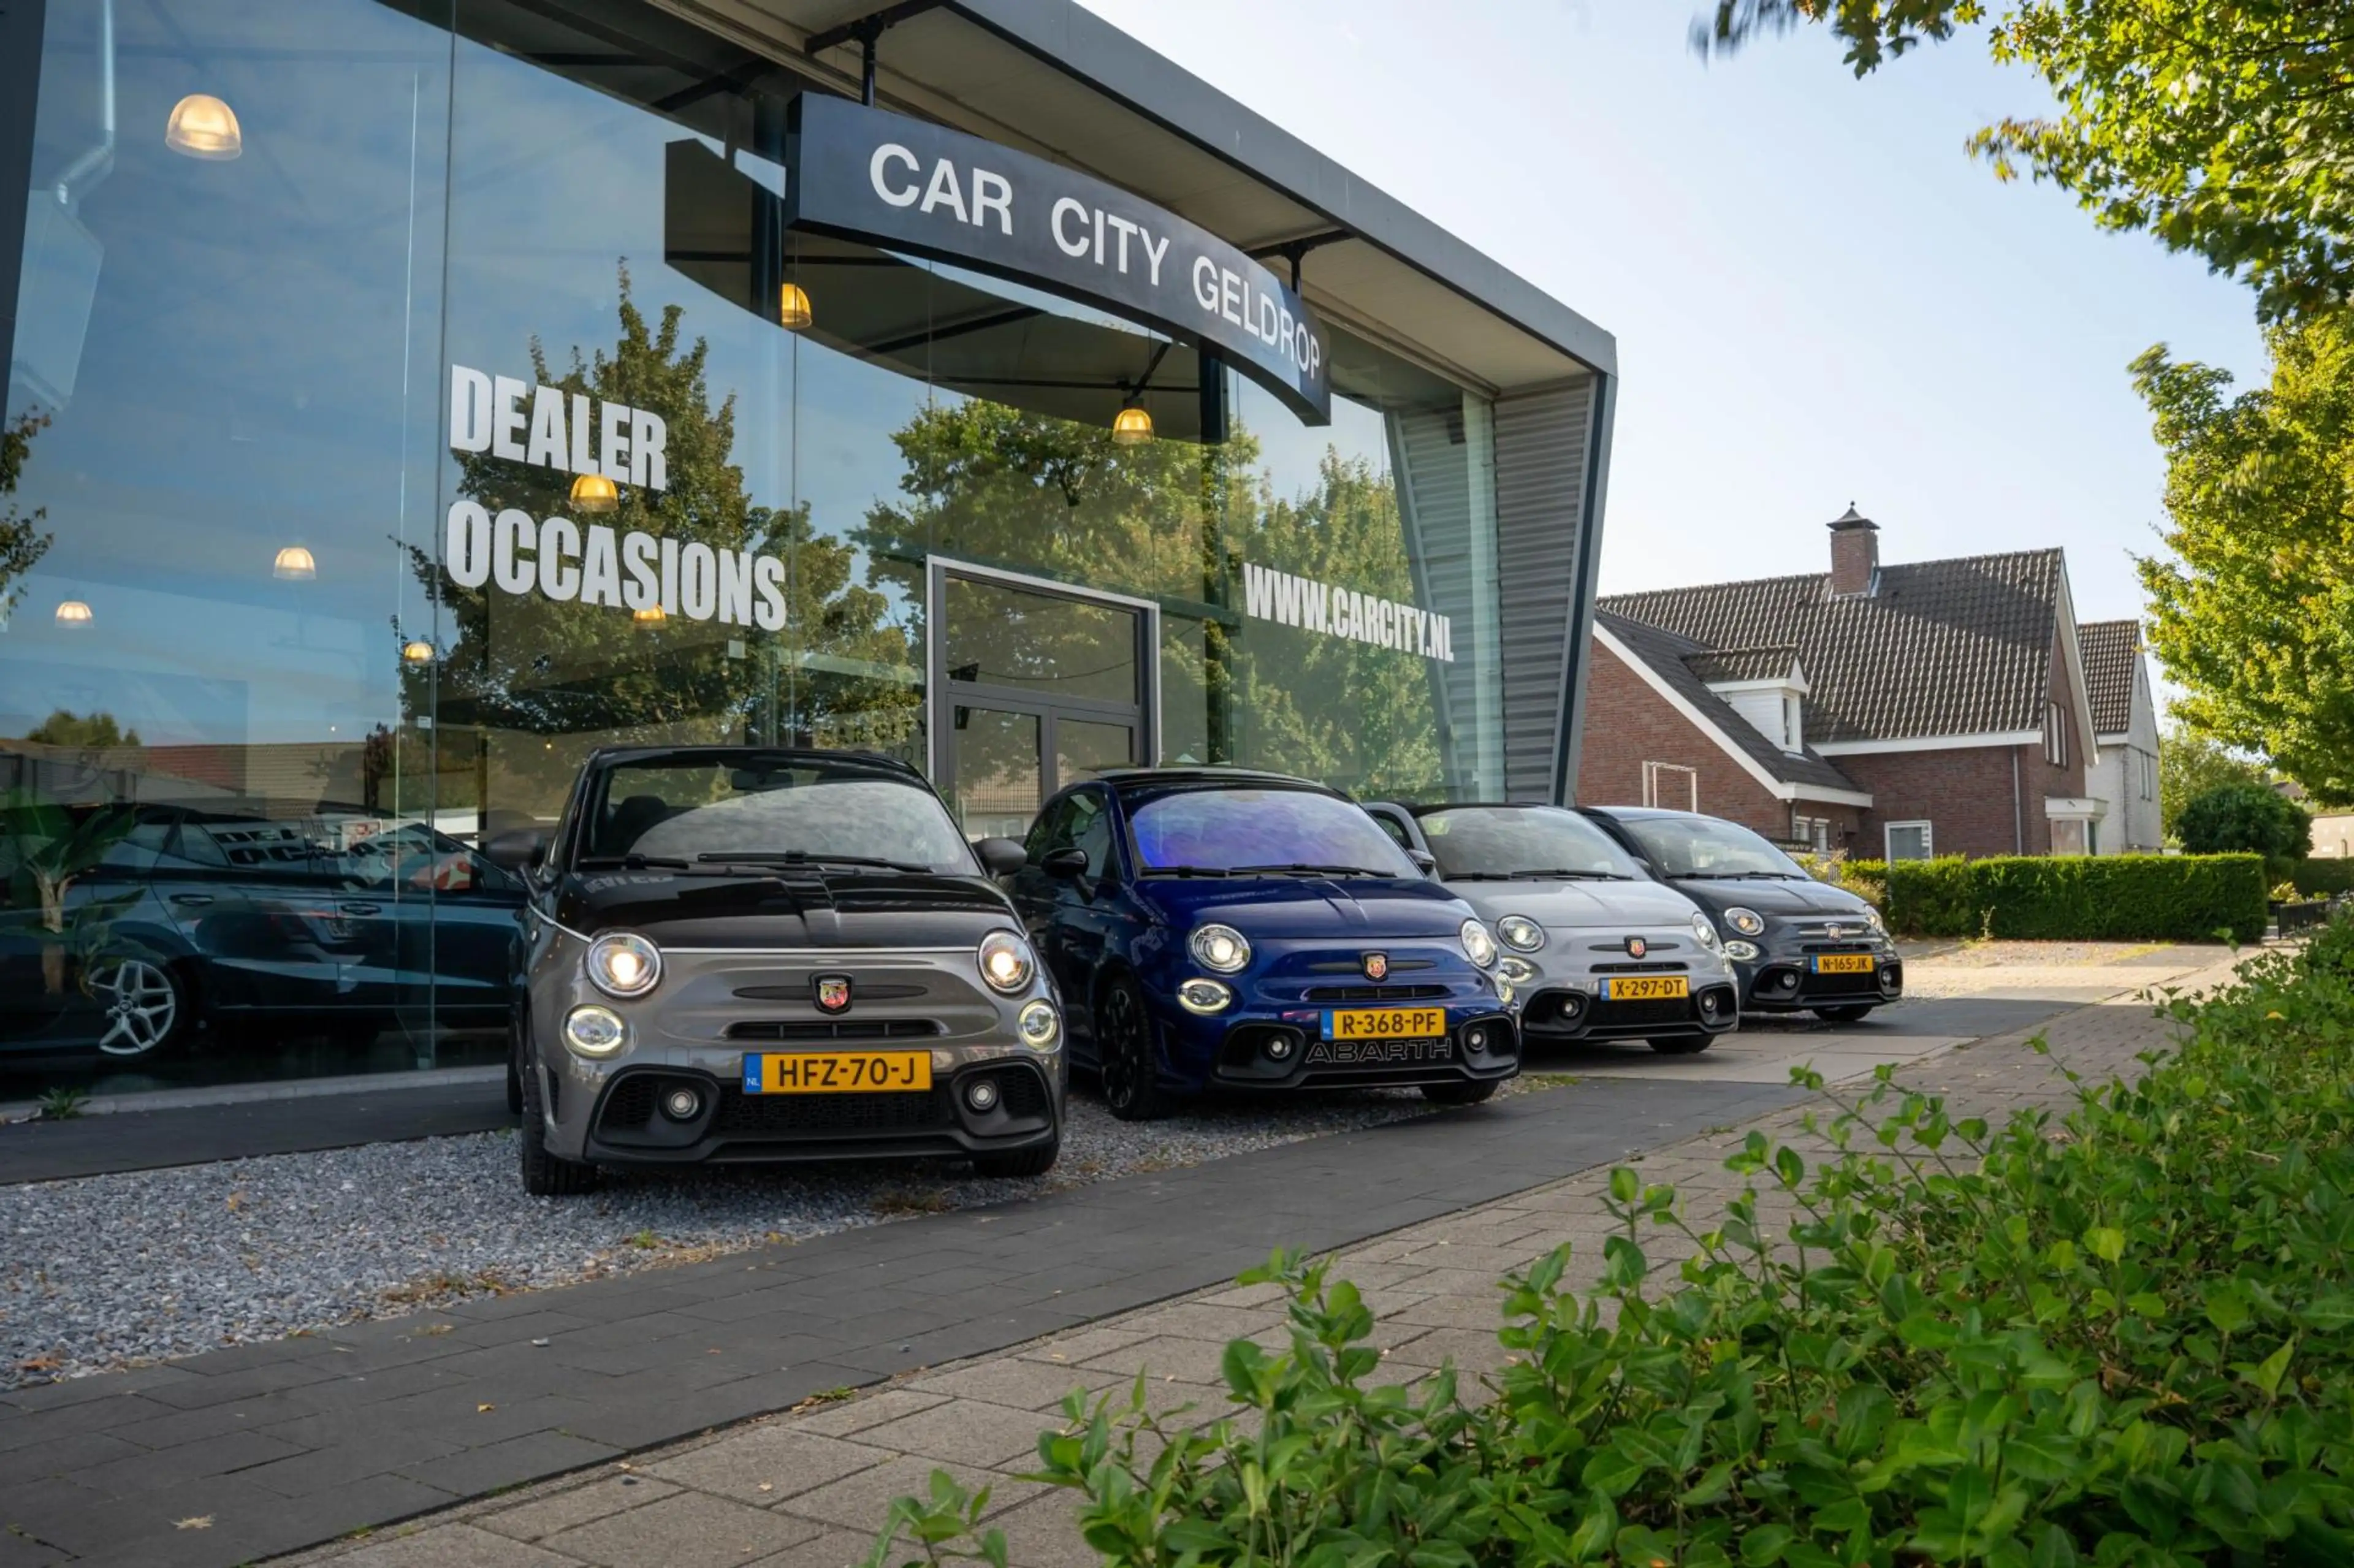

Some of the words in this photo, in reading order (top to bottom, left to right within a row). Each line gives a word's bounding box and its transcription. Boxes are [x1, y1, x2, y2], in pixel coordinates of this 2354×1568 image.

[870, 143, 1013, 235] CAR
[1051, 197, 1170, 286] CITY
[1192, 256, 1321, 379] GELDROP
[449, 364, 667, 491] DEALER
[447, 500, 786, 632] OCCASIONS
[1243, 562, 1454, 663] WWW.CARCITY.NL
[1616, 980, 1683, 997] X-297-DT
[1306, 1037, 1452, 1064] ABARTH
[1342, 1013, 1437, 1035] R-368-PF
[746, 1078, 760, 1086] NL
[779, 1057, 915, 1087] HFZ-70-J
